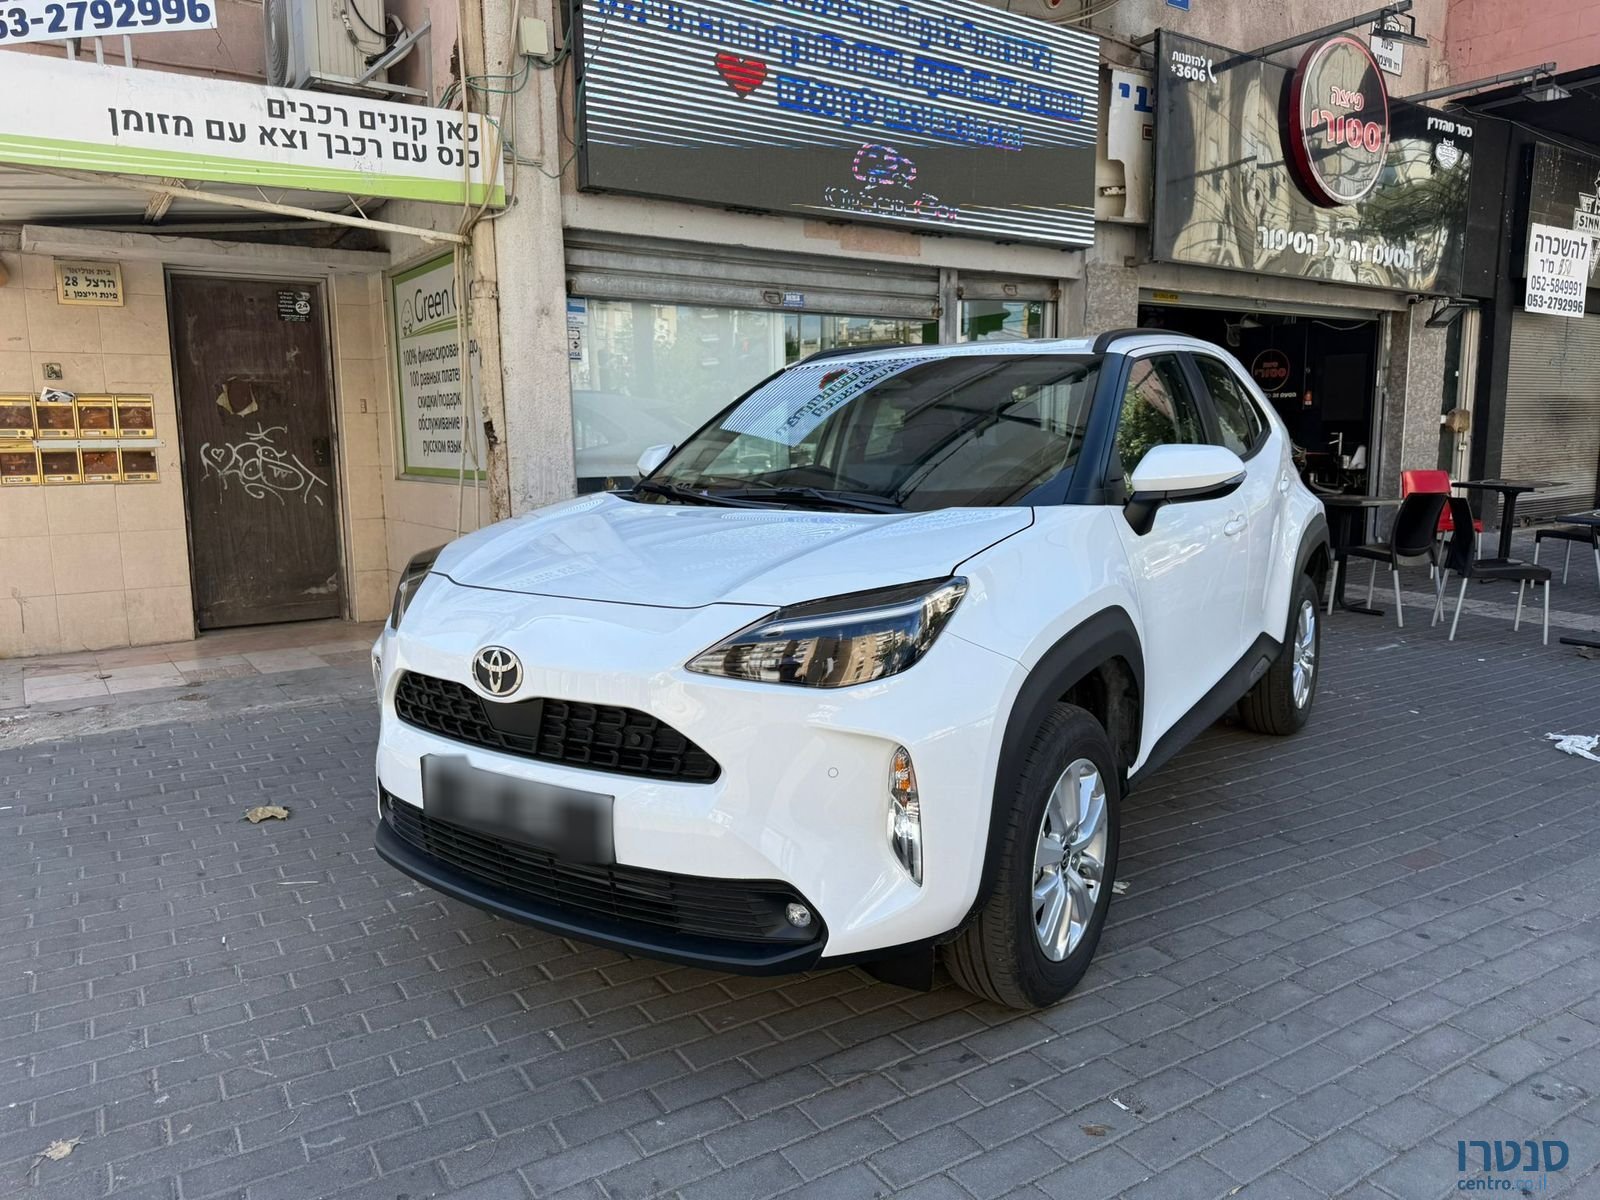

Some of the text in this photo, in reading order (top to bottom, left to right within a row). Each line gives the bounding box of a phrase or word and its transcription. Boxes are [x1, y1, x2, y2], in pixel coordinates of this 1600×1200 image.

[1172, 51, 1206, 68] להזמנות
[1119, 82, 1153, 113] בי
[1331, 86, 1365, 111] פיצה
[266, 98, 479, 144] כאן קונים רכבים
[1311, 108, 1382, 153] סטורי
[1427, 116, 1473, 138] כשר מהדרין
[107, 107, 480, 168] כנס עם רכבך וצא עם מזומן
[1257, 226, 1318, 256] הסיפור
[1324, 231, 1345, 259] כל
[1350, 239, 1368, 263] זה
[1534, 233, 1588, 260] להשכרה
[64, 276, 116, 288] הרצל 28
[64, 289, 118, 299] פינת וייצמן 1
[1531, 275, 1582, 297] 052-5849991
[414, 289, 450, 323] Green
[1527, 293, 1584, 313] 053-2792996
[441, 367, 461, 384] плате
[417, 390, 462, 411] скидки/подарк
[447, 440, 462, 453] язык
